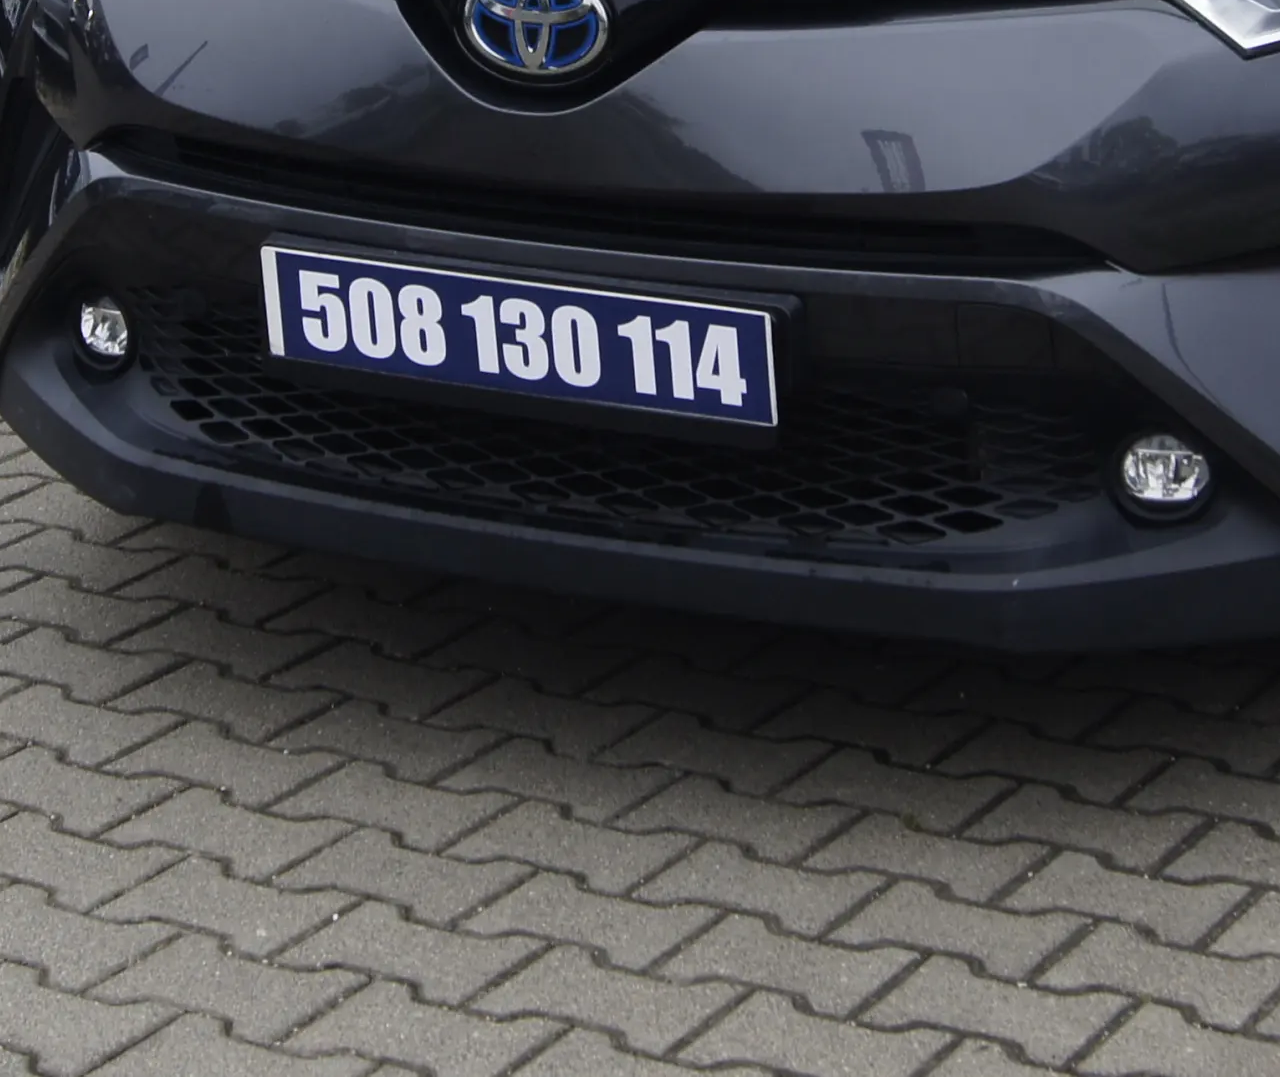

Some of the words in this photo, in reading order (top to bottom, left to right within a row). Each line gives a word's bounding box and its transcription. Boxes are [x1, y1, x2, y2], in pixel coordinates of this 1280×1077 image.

[297, 269, 447, 367] 508
[461, 294, 602, 388] 130
[617, 314, 748, 407] 114
